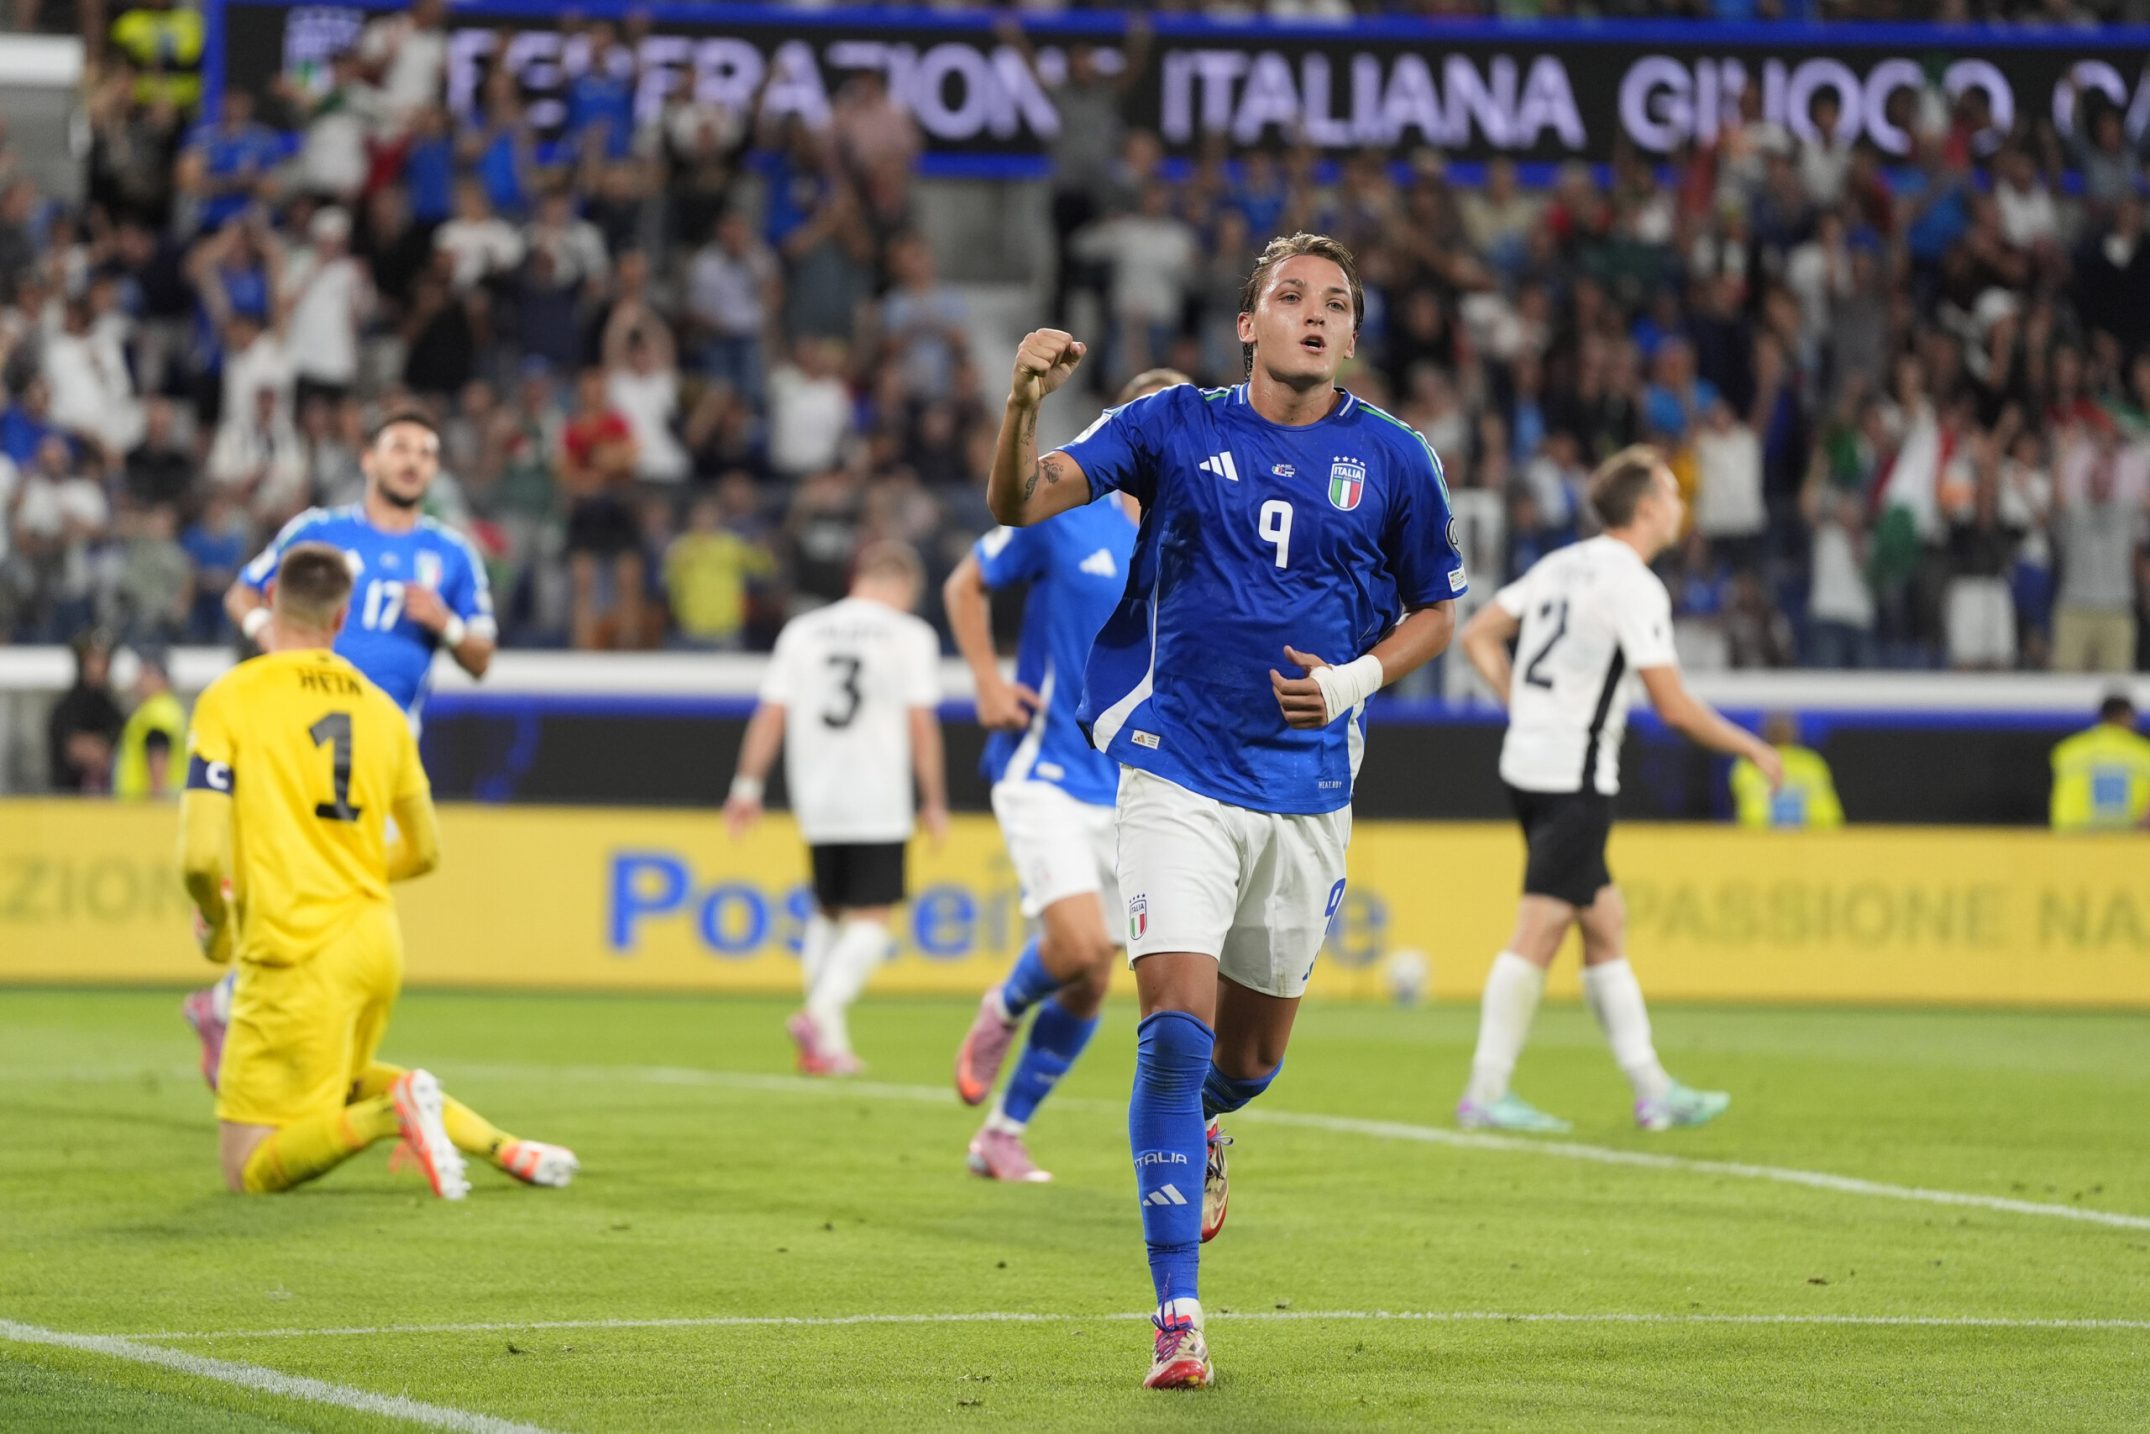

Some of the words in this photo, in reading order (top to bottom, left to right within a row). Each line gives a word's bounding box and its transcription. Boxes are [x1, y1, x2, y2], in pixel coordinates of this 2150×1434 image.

[1161, 50, 1587, 150] ITALIANA
[1334, 466, 1362, 480] ITALIA
[1258, 499, 1294, 569] 9
[361, 578, 405, 631] 17
[1525, 598, 1568, 689] 2
[820, 653, 863, 730] 3
[206, 760, 229, 790] C
[308, 710, 363, 822] 1
[1134, 1151, 1188, 1169] ITALIA
